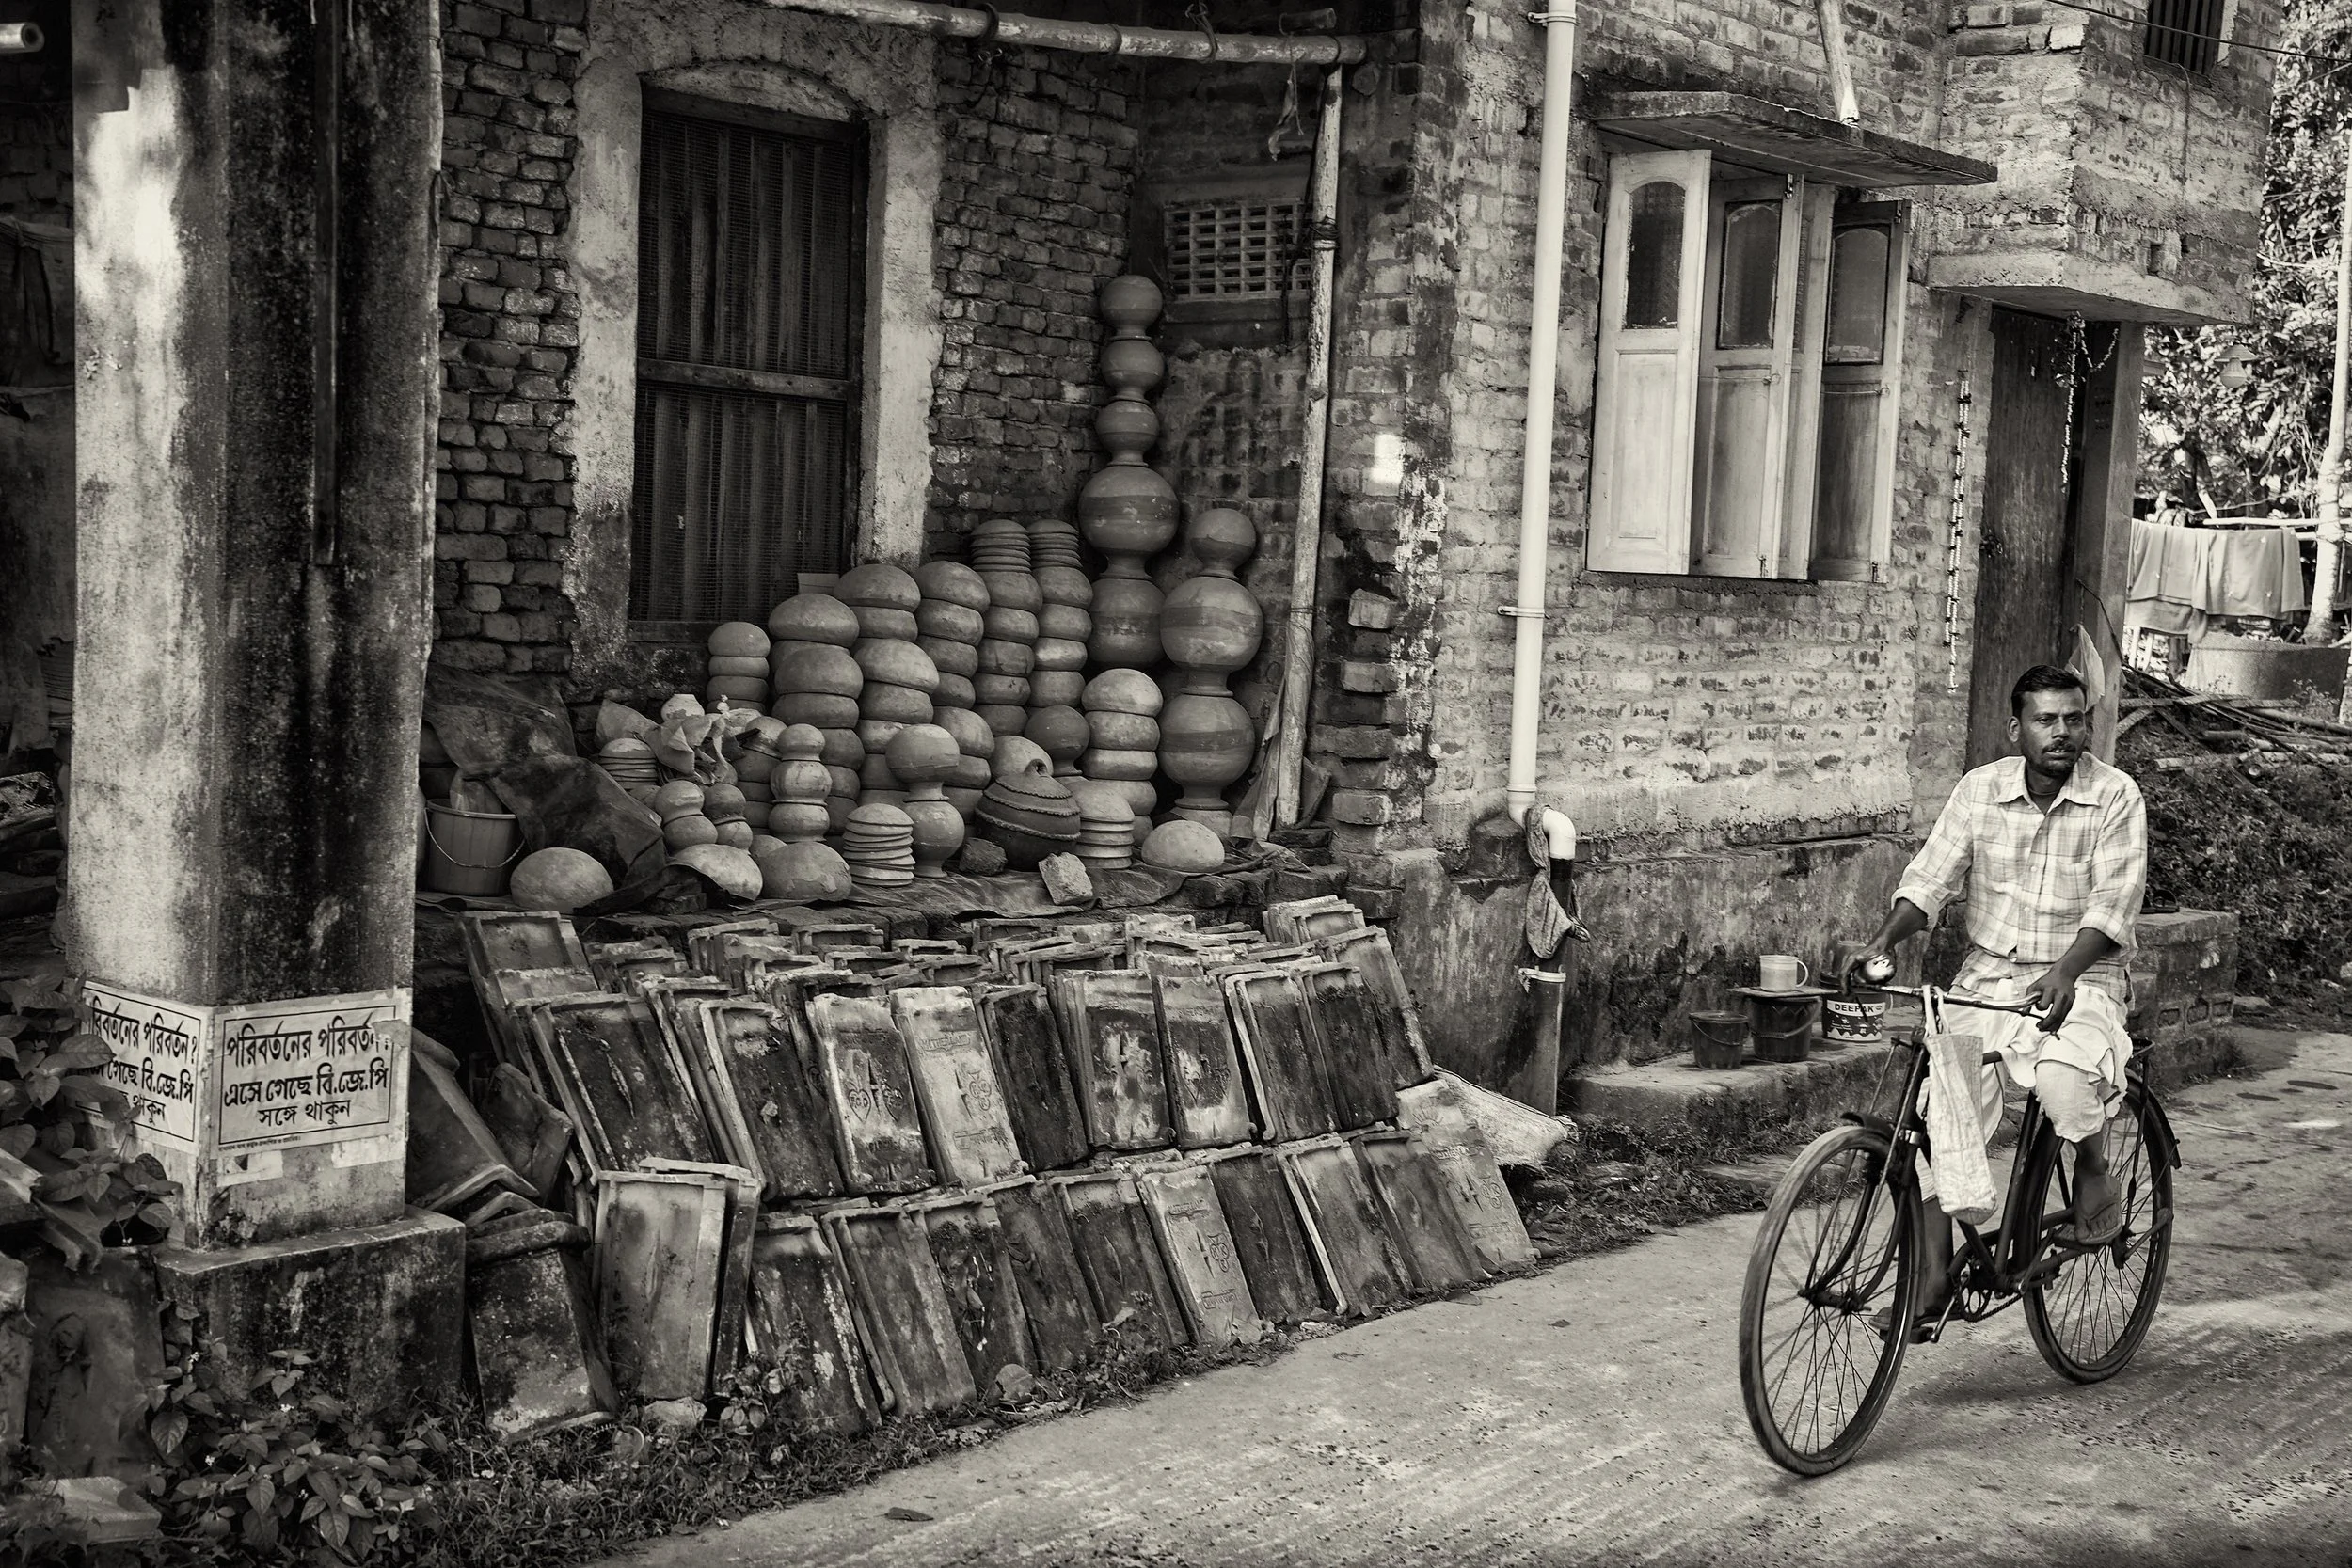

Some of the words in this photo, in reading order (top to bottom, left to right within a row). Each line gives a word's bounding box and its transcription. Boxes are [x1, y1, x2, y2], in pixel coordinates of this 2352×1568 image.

[226, 1020, 313, 1068] পরিবর্তনের
[224, 1081, 262, 1107] এসে
[265, 1075, 313, 1101] গেছে
[258, 1105, 298, 1127] সঙ্গে
[305, 1100, 352, 1125] থাকুন
